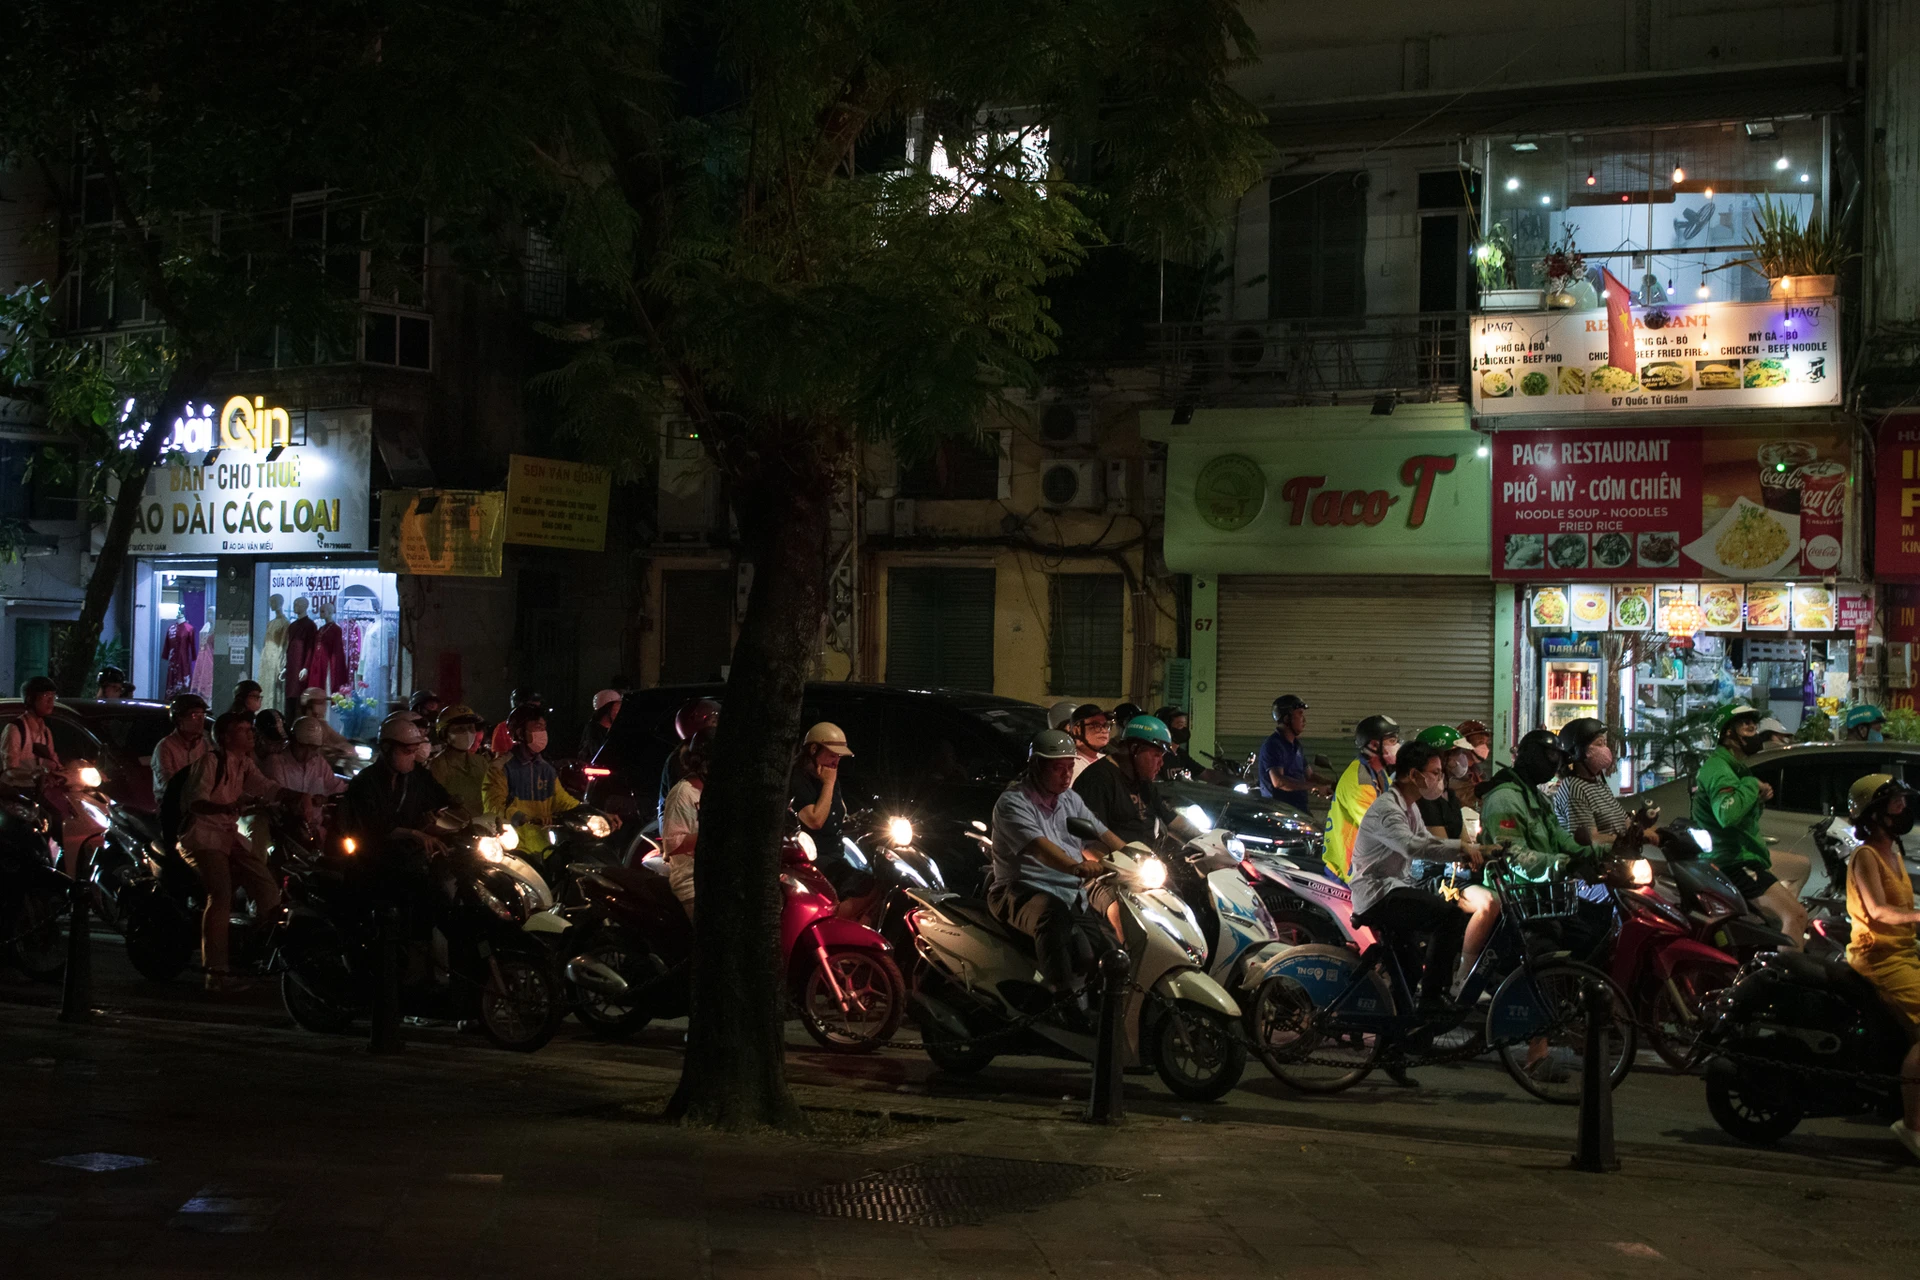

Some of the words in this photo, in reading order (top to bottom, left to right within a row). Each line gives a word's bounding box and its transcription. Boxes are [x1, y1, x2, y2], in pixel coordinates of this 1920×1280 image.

[1791, 306, 1820, 318] PA67
[1487, 321, 1514, 332] PA67
[1765, 330, 1777, 341] GÀ
[1657, 348, 1682, 358] FRIED
[1720, 345, 1759, 356] CHICKEN
[1768, 343, 1790, 353] BEEF
[1792, 342, 1828, 352] NOODLE
[1523, 354, 1543, 364] BEEF
[1611, 396, 1622, 406] 67
[1625, 394, 1648, 407] Quốc
[1664, 394, 1688, 405] Giám
[1512, 442, 1554, 466] PA67
[1562, 438, 1671, 465] RESTAURANT
[217, 462, 251, 490] CHO
[1282, 475, 1400, 527] Taco
[1399, 453, 1458, 531] T
[1503, 473, 1538, 503] PHỞ
[1550, 473, 1577, 502] MỲ
[1589, 474, 1626, 502] CƠM
[1630, 471, 1682, 500] CHIÊN
[172, 493, 215, 535] DÀI
[222, 492, 273, 534] CÁC
[1515, 508, 1564, 520] NOODLE
[1567, 508, 1600, 519] SOUP
[1610, 506, 1668, 518] NOODLES
[1559, 521, 1593, 532] FRIED
[1596, 520, 1623, 531] RICE
[1901, 524, 1915, 537] IN
[1901, 607, 1915, 626] IN
[1194, 618, 1213, 631] 67
[1307, 880, 1329, 894] LOUIS
